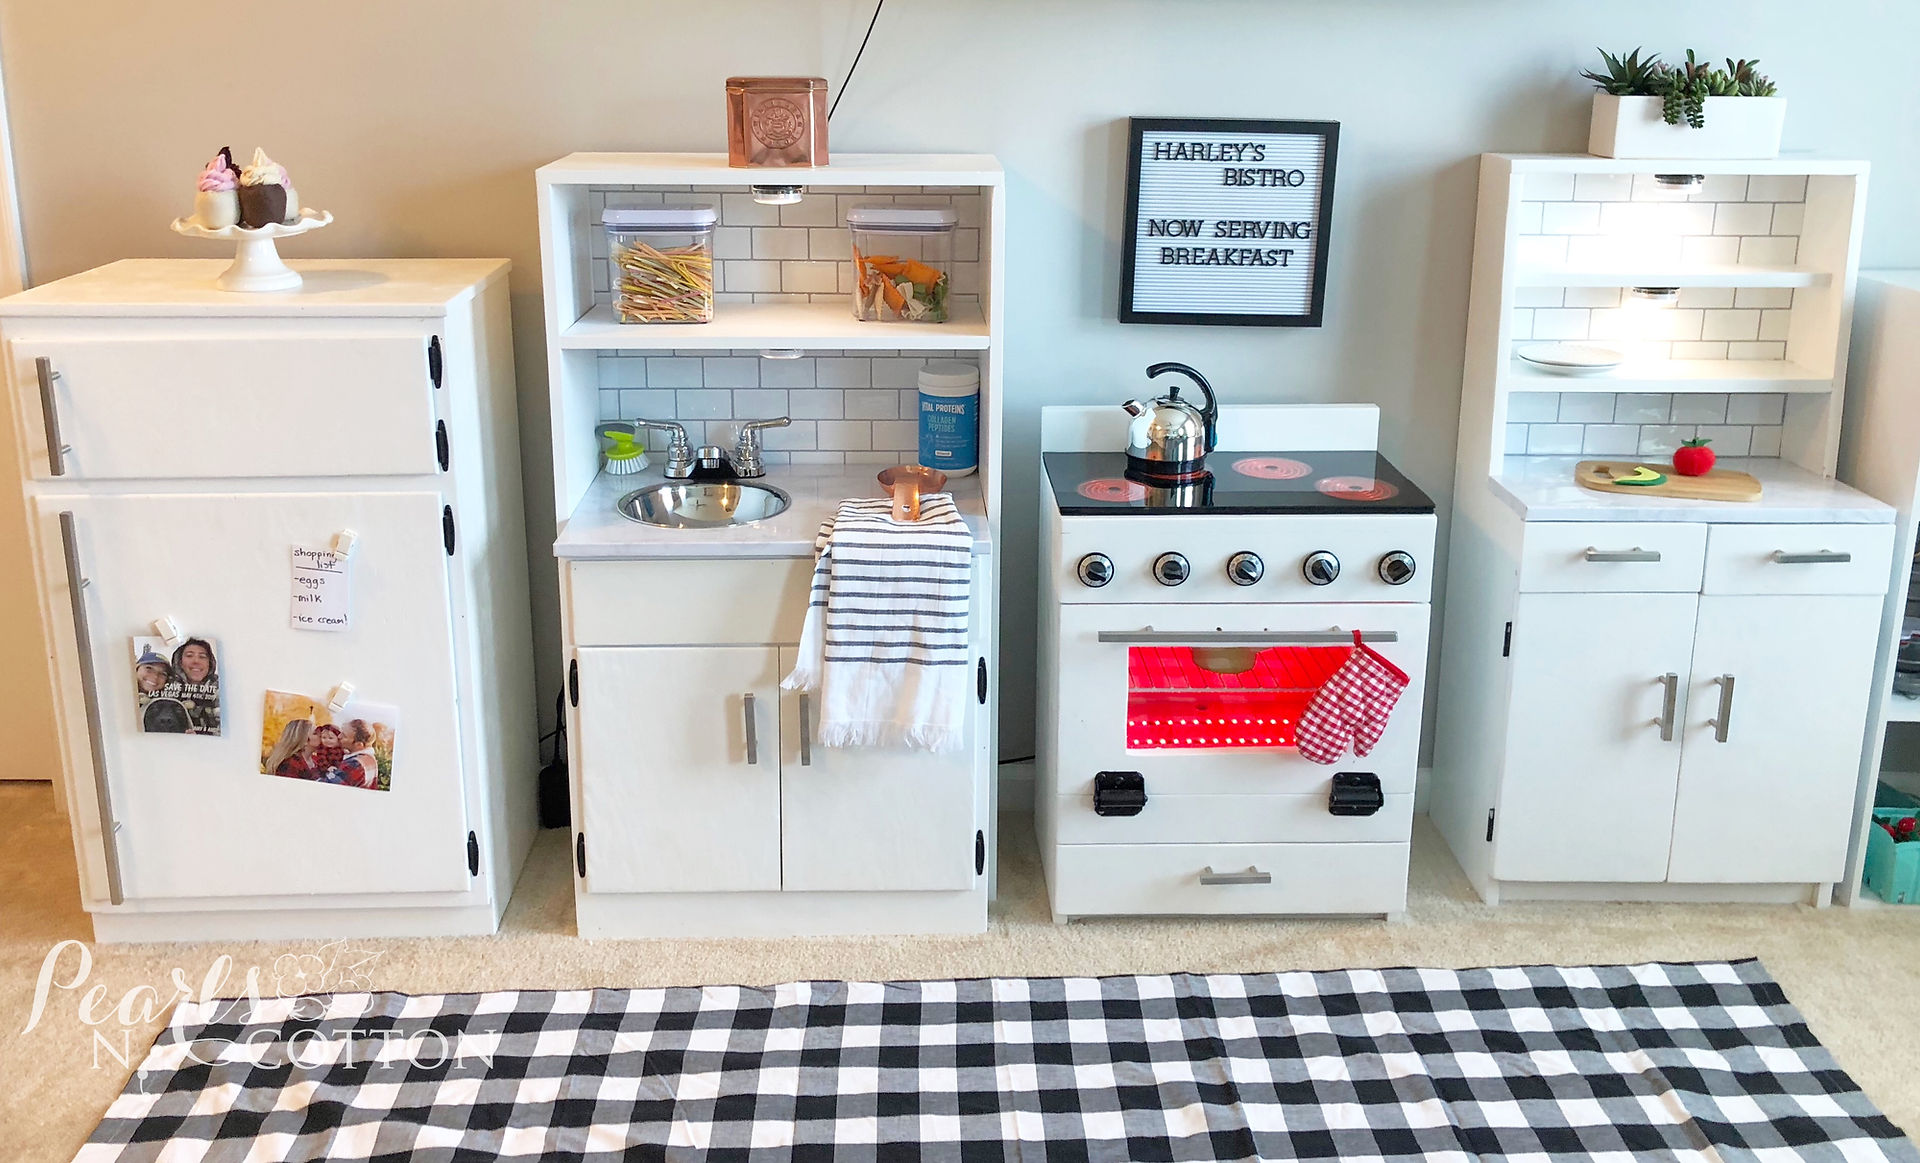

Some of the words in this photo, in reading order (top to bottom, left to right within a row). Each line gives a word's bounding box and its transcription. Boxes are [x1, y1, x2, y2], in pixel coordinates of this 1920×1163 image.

[1153, 142, 1266, 162] HARLEY'S
[1223, 168, 1305, 187] BISTRO
[1148, 219, 1204, 237] NOW
[1214, 220, 1313, 239] SERVING
[1160, 247, 1294, 267] BREAKFAST
[936, 404, 965, 415] PROTEINS
[317, 560, 335, 569] list
[318, 614, 348, 625] cream!
[148, 690, 159, 698] LAS
[160, 690, 180, 698] VEGAS
[164, 682, 182, 692] SAVE
[184, 683, 198, 692] THE
[200, 684, 217, 694] DATE
